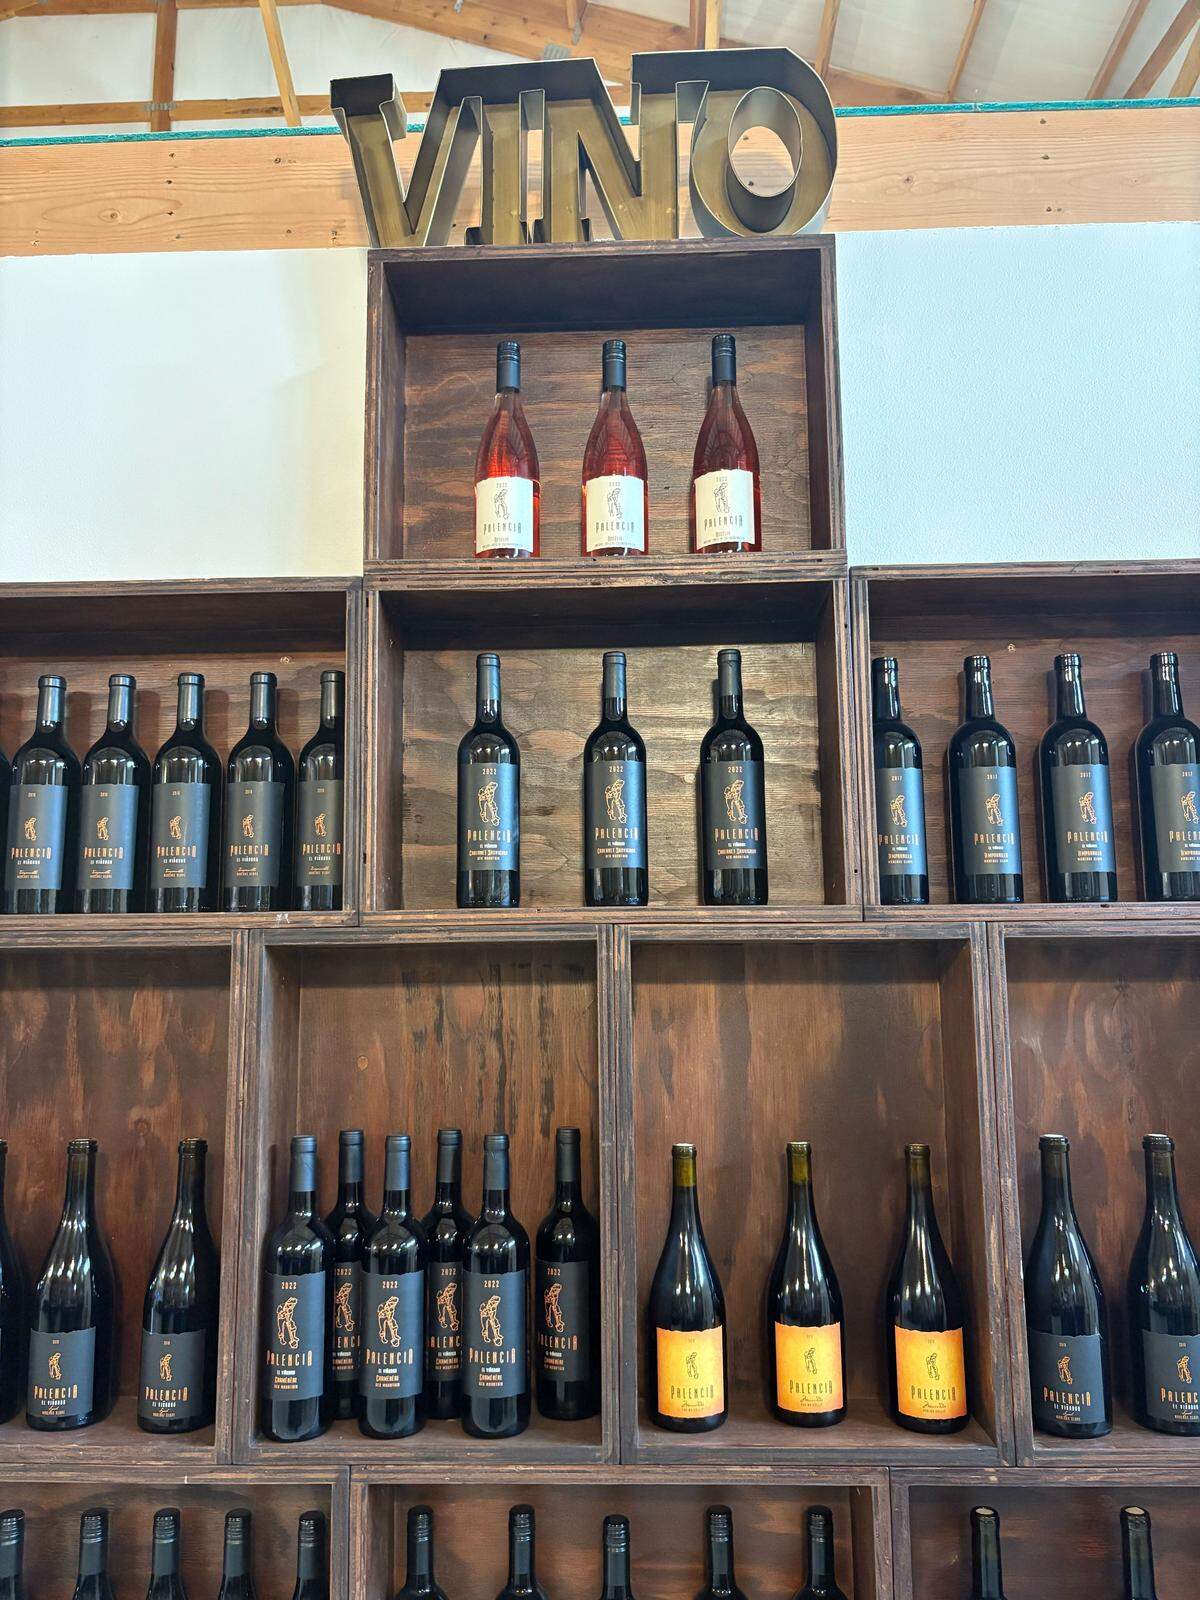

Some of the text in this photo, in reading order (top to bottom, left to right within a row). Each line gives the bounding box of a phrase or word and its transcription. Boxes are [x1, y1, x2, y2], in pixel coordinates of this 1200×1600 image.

[329, 47, 838, 247] VINO
[483, 522, 521, 535] PALENCIA
[596, 521, 634, 534] PALENCIA
[704, 515, 743, 531] PALENCIA
[467, 829, 511, 843] PALENCIA
[595, 827, 638, 840] PALENCIA
[715, 827, 758, 841] PALENCIA
[974, 832, 1015, 845] PALENCIA
[1067, 831, 1108, 844] PALENCIA
[281, 1282, 297, 1290] 2022
[484, 1280, 500, 1288] 2022
[266, 1350, 313, 1367] PALENCIA
[366, 1348, 413, 1365] PALENCIA
[469, 1347, 516, 1364] PALENCIA
[34, 1385, 78, 1400] PALENCIA
[145, 1386, 188, 1402] PALENCIA
[671, 1385, 714, 1400] PALENCIA
[790, 1379, 833, 1394] PALENCIA
[911, 1385, 956, 1401] PALENCIA
[1043, 1386, 1091, 1407] PALENCIA
